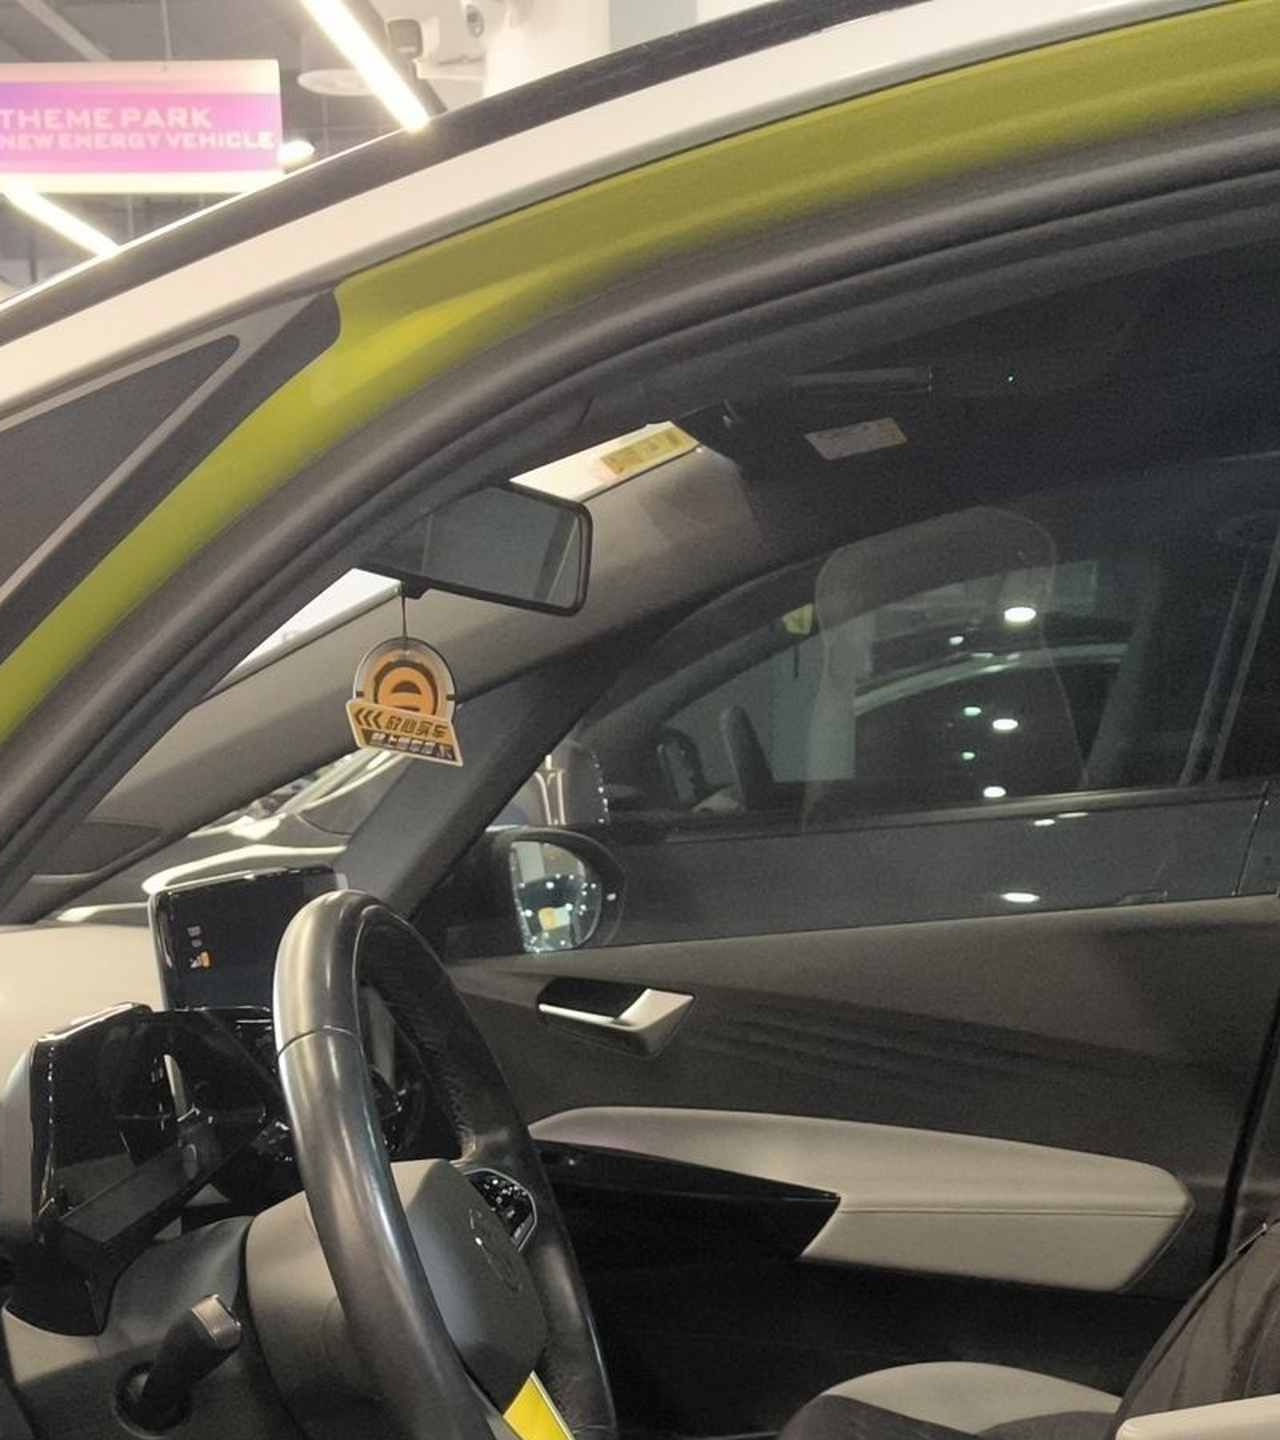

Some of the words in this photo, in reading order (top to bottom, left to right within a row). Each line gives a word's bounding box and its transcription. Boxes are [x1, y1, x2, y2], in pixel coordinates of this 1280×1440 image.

[120, 106, 214, 130] PARK
[59, 132, 161, 151] ENERGY
[166, 131, 277, 151] VEHICLE
